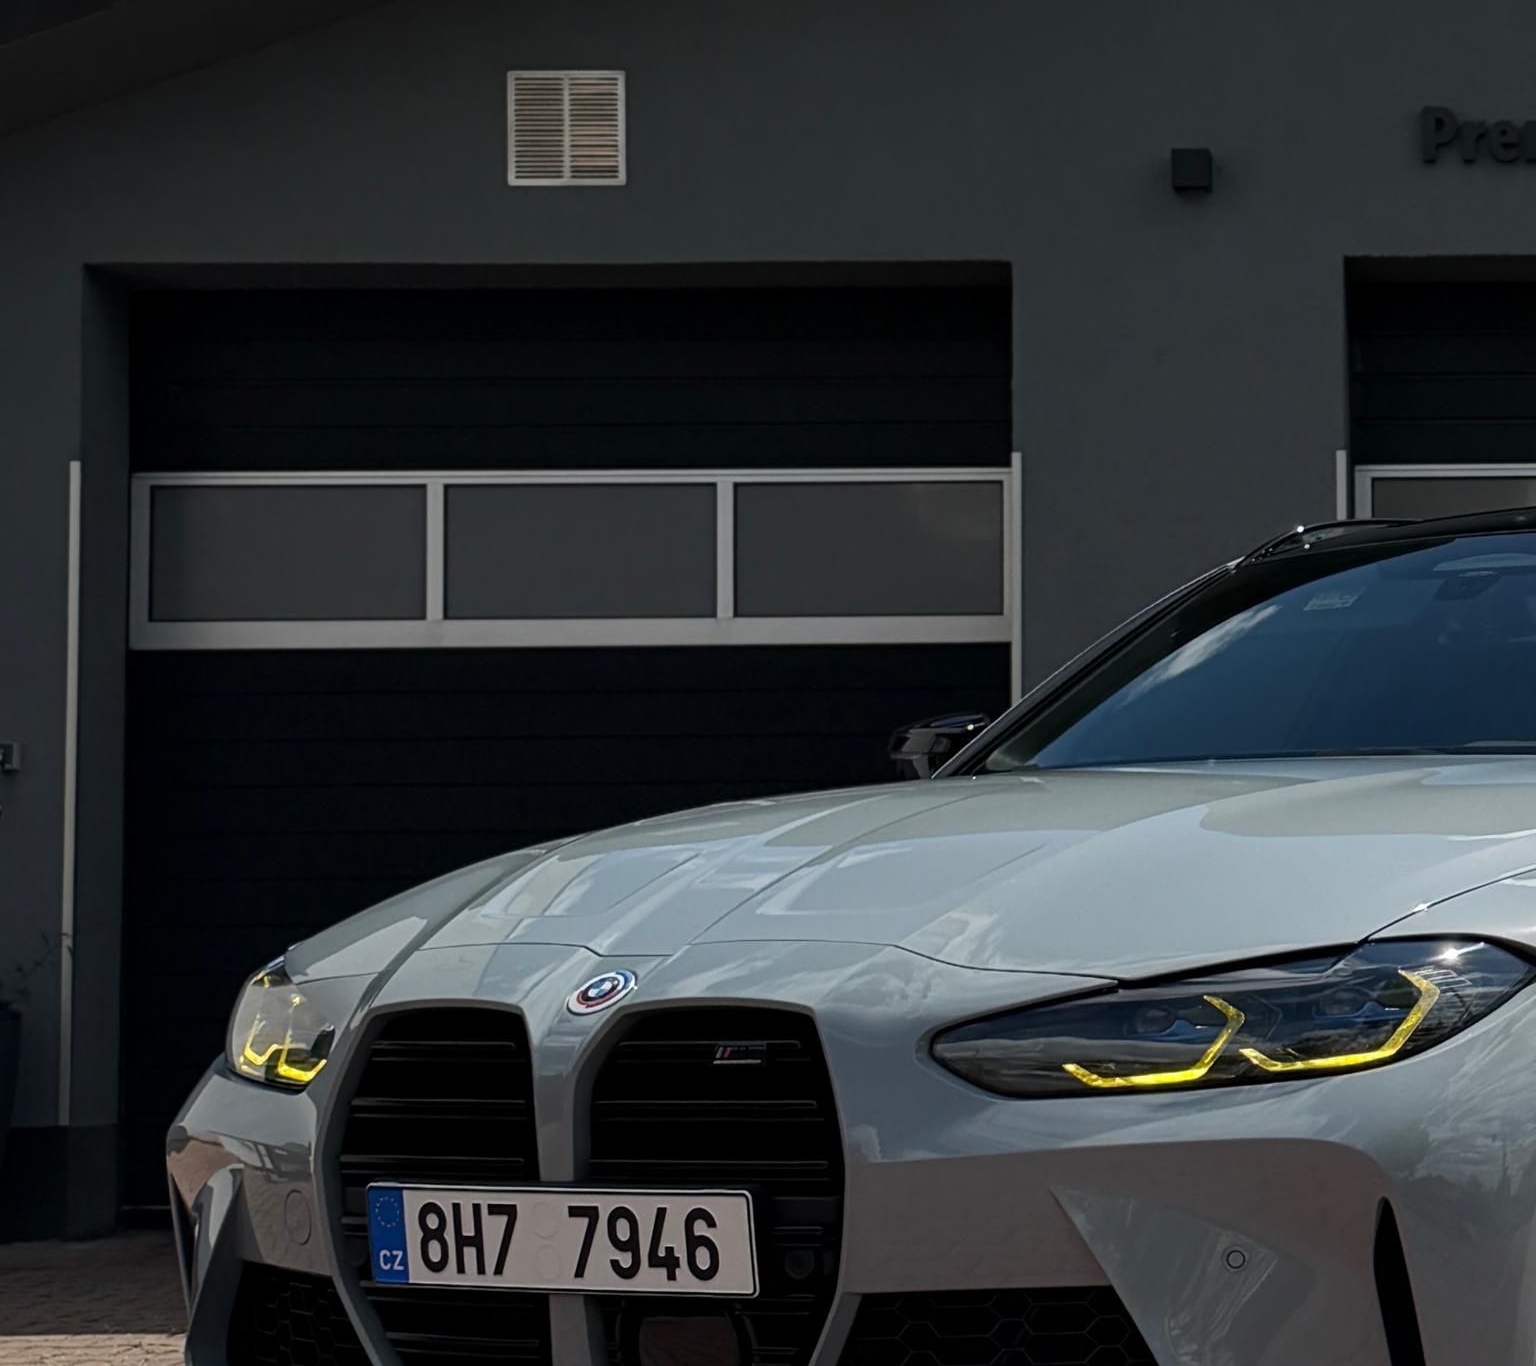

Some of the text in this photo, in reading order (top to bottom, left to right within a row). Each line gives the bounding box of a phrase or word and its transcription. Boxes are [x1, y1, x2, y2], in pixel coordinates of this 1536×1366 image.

[379, 1249, 404, 1272] CZ
[418, 1201, 720, 1281] 8H7 7946
